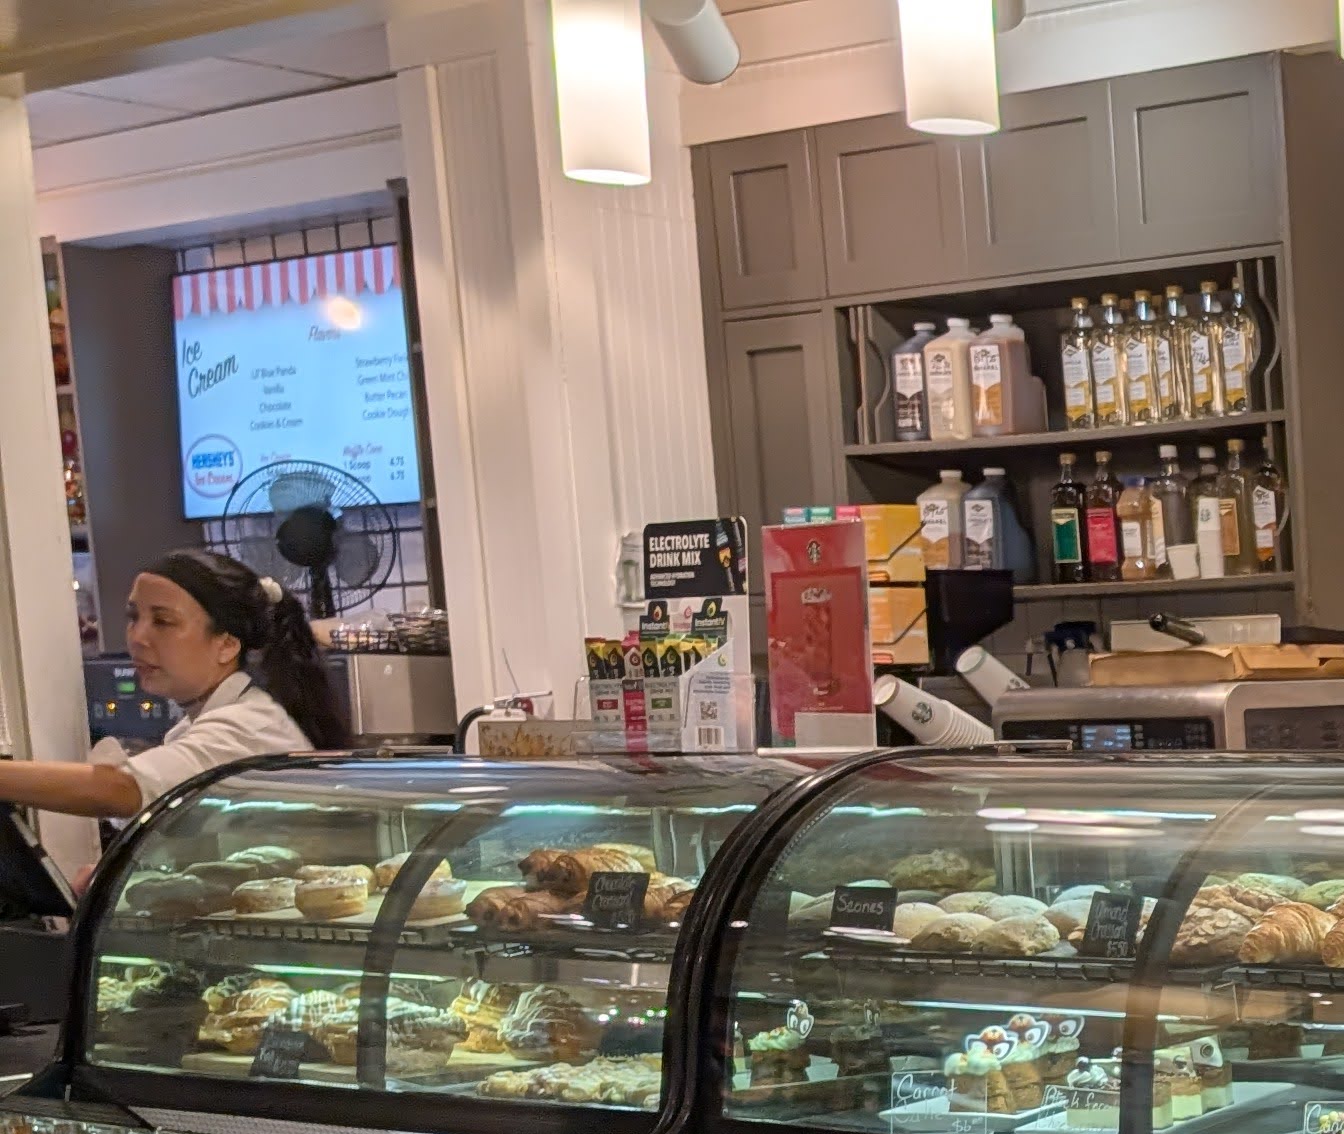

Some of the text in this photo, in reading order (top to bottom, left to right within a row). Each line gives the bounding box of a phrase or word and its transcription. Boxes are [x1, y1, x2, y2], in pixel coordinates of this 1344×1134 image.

[182, 339, 203, 368] Ice
[188, 355, 239, 399] Cream
[649, 534, 711, 551] ELECTROLYTE
[650, 551, 701, 568] DRINK MIX
[836, 894, 884, 915] Scones
